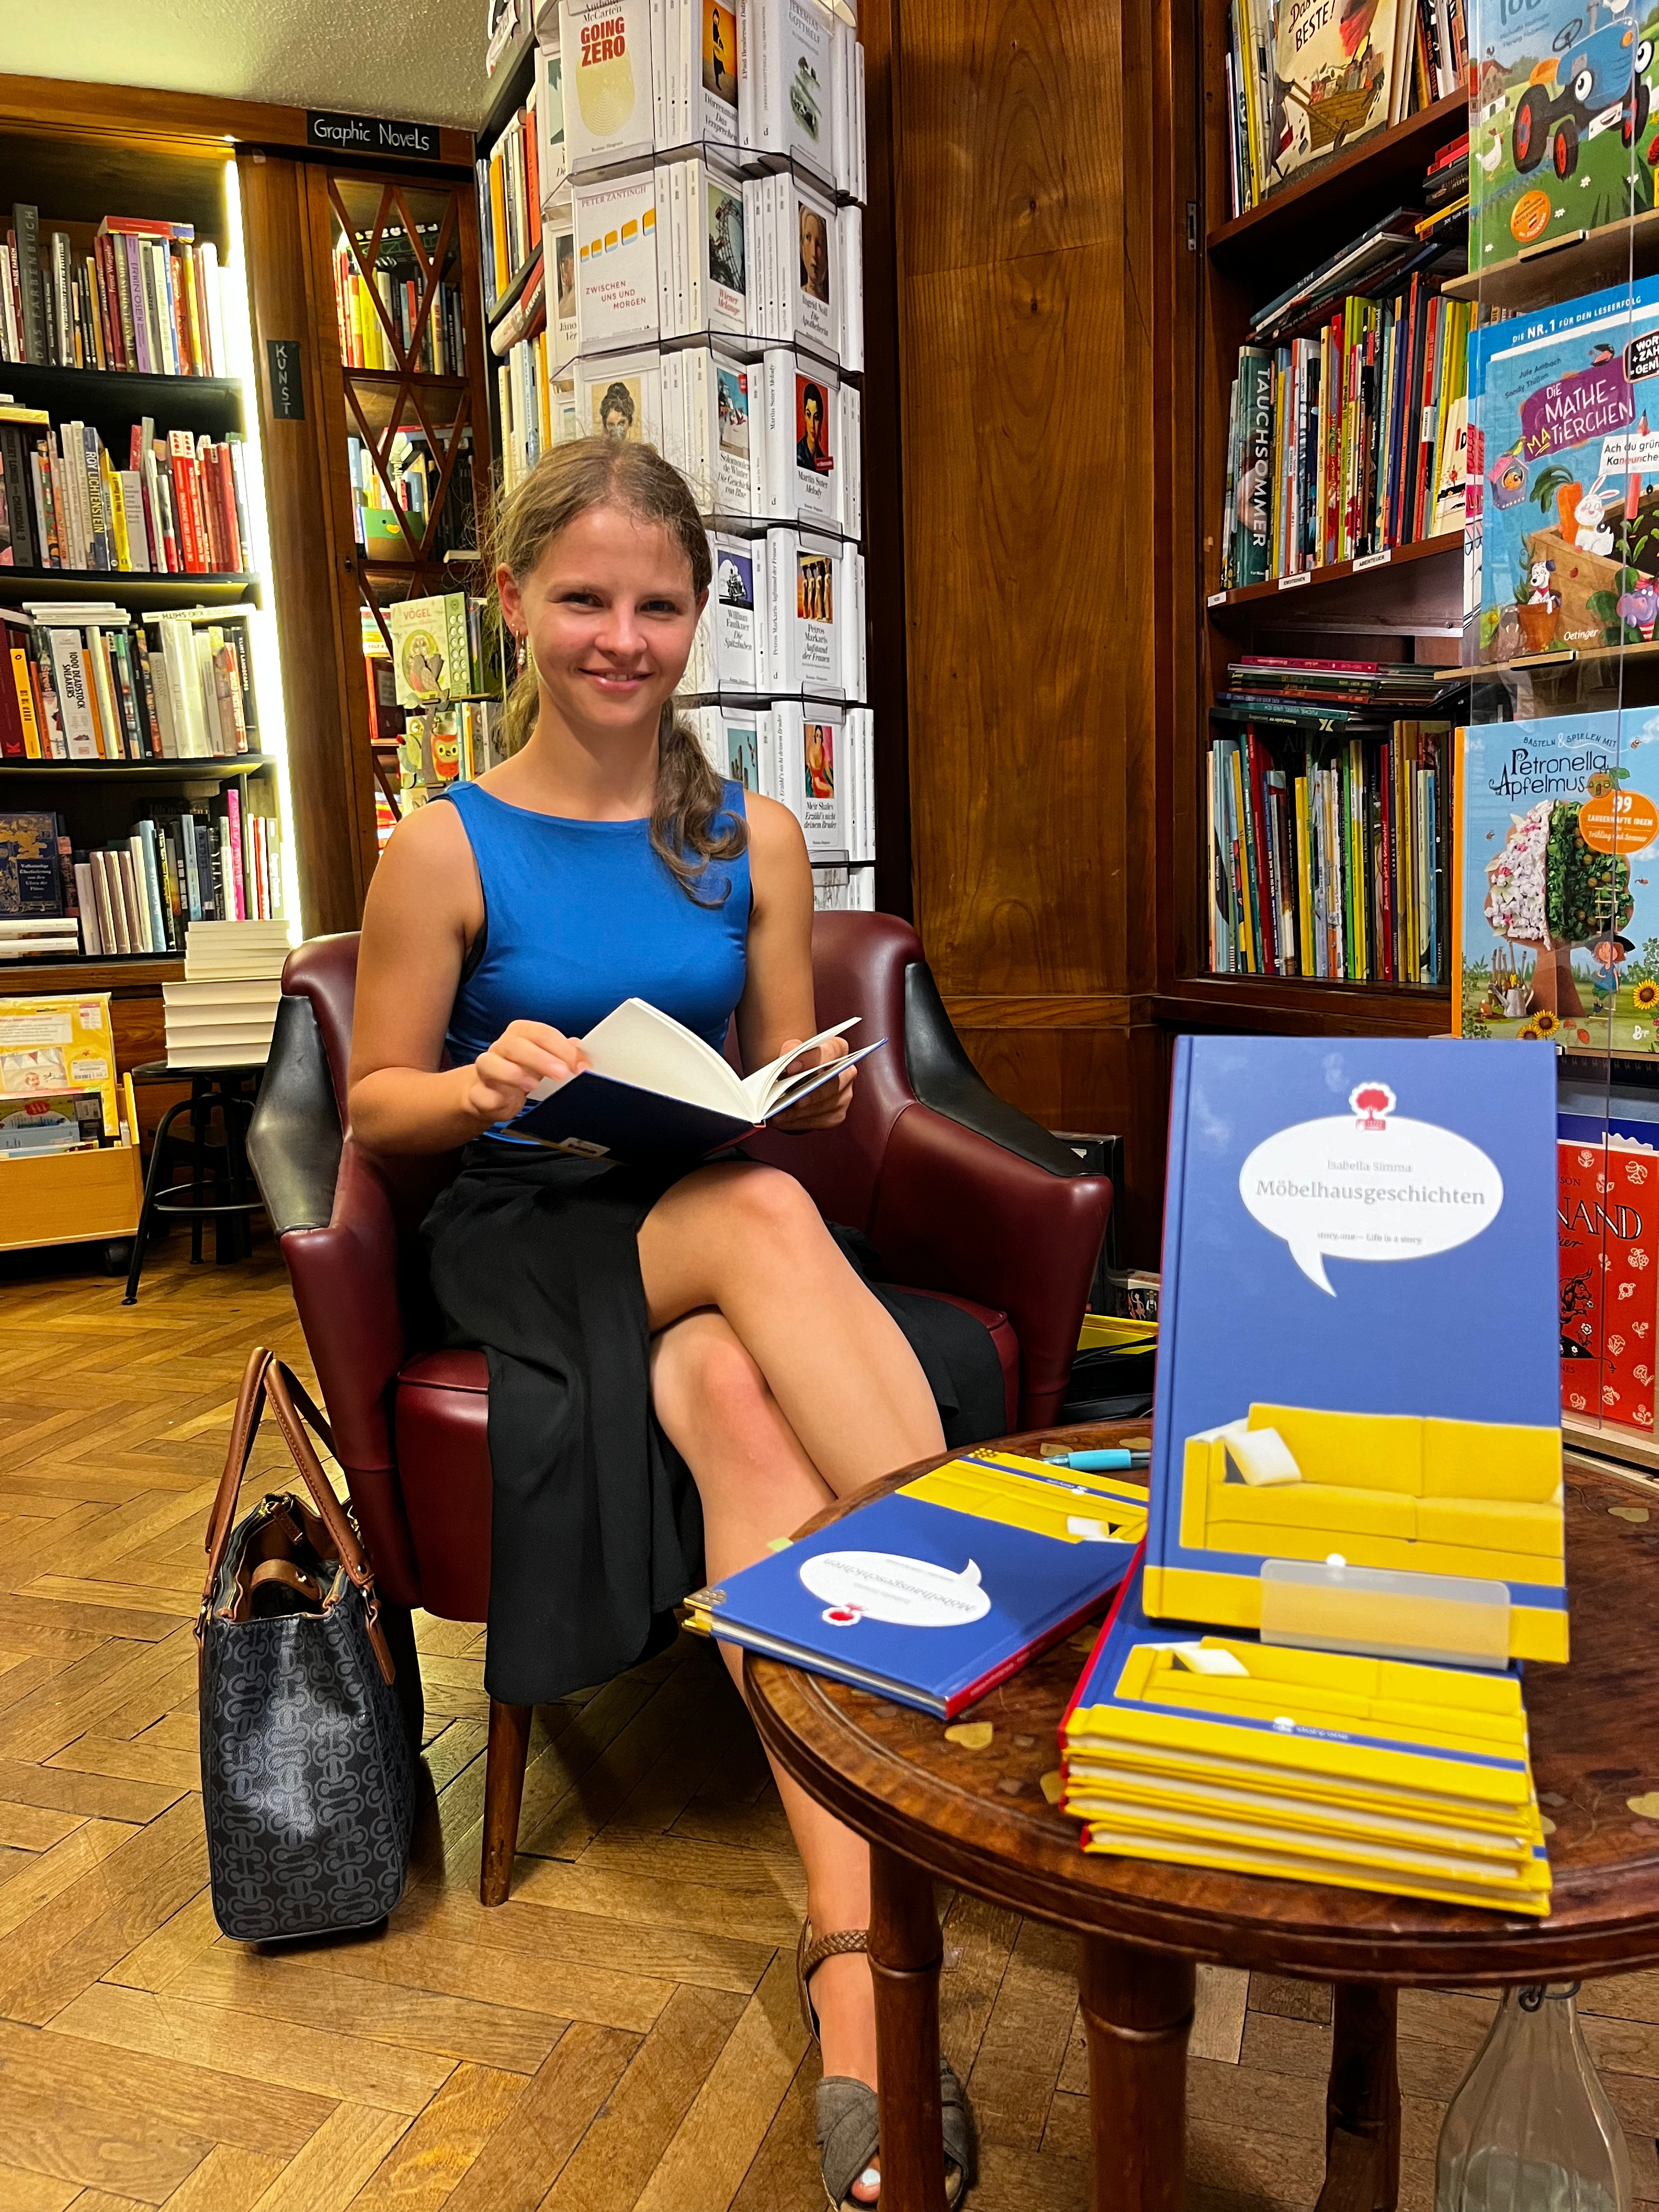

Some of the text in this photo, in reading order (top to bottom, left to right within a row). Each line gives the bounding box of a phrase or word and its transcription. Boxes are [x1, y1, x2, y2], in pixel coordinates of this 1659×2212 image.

[789, 0, 819, 31] JEREMIAS
[580, 16, 625, 44] GOING
[788, 12, 821, 44] GOTTHELF
[1296, 0, 1335, 52] BESTE!
[582, 35, 625, 67] ZERO
[715, 112, 727, 127] Das
[313, 119, 430, 151] Graphic Novels
[582, 185, 647, 207] PETER ZANTINGH
[104, 245, 116, 292] Franz Wiegele
[25, 211, 44, 359] DAS FARBENBUCH
[586, 280, 626, 295] ZWISCHEN
[601, 289, 635, 302] UNS UND
[613, 297, 646, 310] MORGEN
[719, 288, 740, 304] Wiener
[134, 295, 144, 321] OSEN
[1513, 296, 1641, 343] DIE NR. 1 FÜR DEN LESEERFOLG
[1519, 357, 1562, 380] Jule Ambach
[275, 345, 291, 415] KUNST
[1504, 385, 1525, 399] Sandy
[1604, 441, 1621, 454] Ach
[1624, 439, 1637, 452] du
[1253, 368, 1271, 546] TAUCHSOMMER
[798, 471, 828, 489] Martin Suter
[86, 451, 105, 533] ROY LICHTENSTEIN
[806, 483, 823, 499] Melody
[1358, 554, 1385, 566] ABENTEUER
[1283, 576, 1306, 585] EMOTIONEN
[404, 608, 431, 620] VÖGEL
[727, 609, 748, 622] William
[726, 618, 750, 631] Faulkner
[808, 624, 825, 635] Petros
[733, 630, 743, 640] Die
[805, 633, 828, 644] Markaris
[1563, 628, 1599, 641] Oetinger
[802, 651, 830, 663] der Frauen
[63, 664, 75, 698] SNEAKERS
[69, 652, 86, 709] 1000 DEADSTOCK
[1523, 736, 1556, 747] BASTELN
[1566, 733, 1601, 743] SPIELEN
[1602, 738, 1617, 748] MIT
[1511, 748, 1608, 776] Petronella
[1489, 762, 1587, 802] Apfelmus
[806, 802, 834, 811] Meir Shalev
[1612, 795, 1632, 814] 99
[822, 821, 837, 830] Bruder
[1587, 815, 1654, 826] ZAUBERHAFTE IDEEN
[1624, 832, 1647, 843] Sommer
[1327, 1159, 1413, 1173] Isabella Simma
[1558, 1175, 1581, 1188] SON
[1255, 1179, 1486, 1205] Möbelhausgeschichten
[1400, 1235, 1423, 1245] story
[822, 1557, 977, 1613] Möbelhausgeschichten
